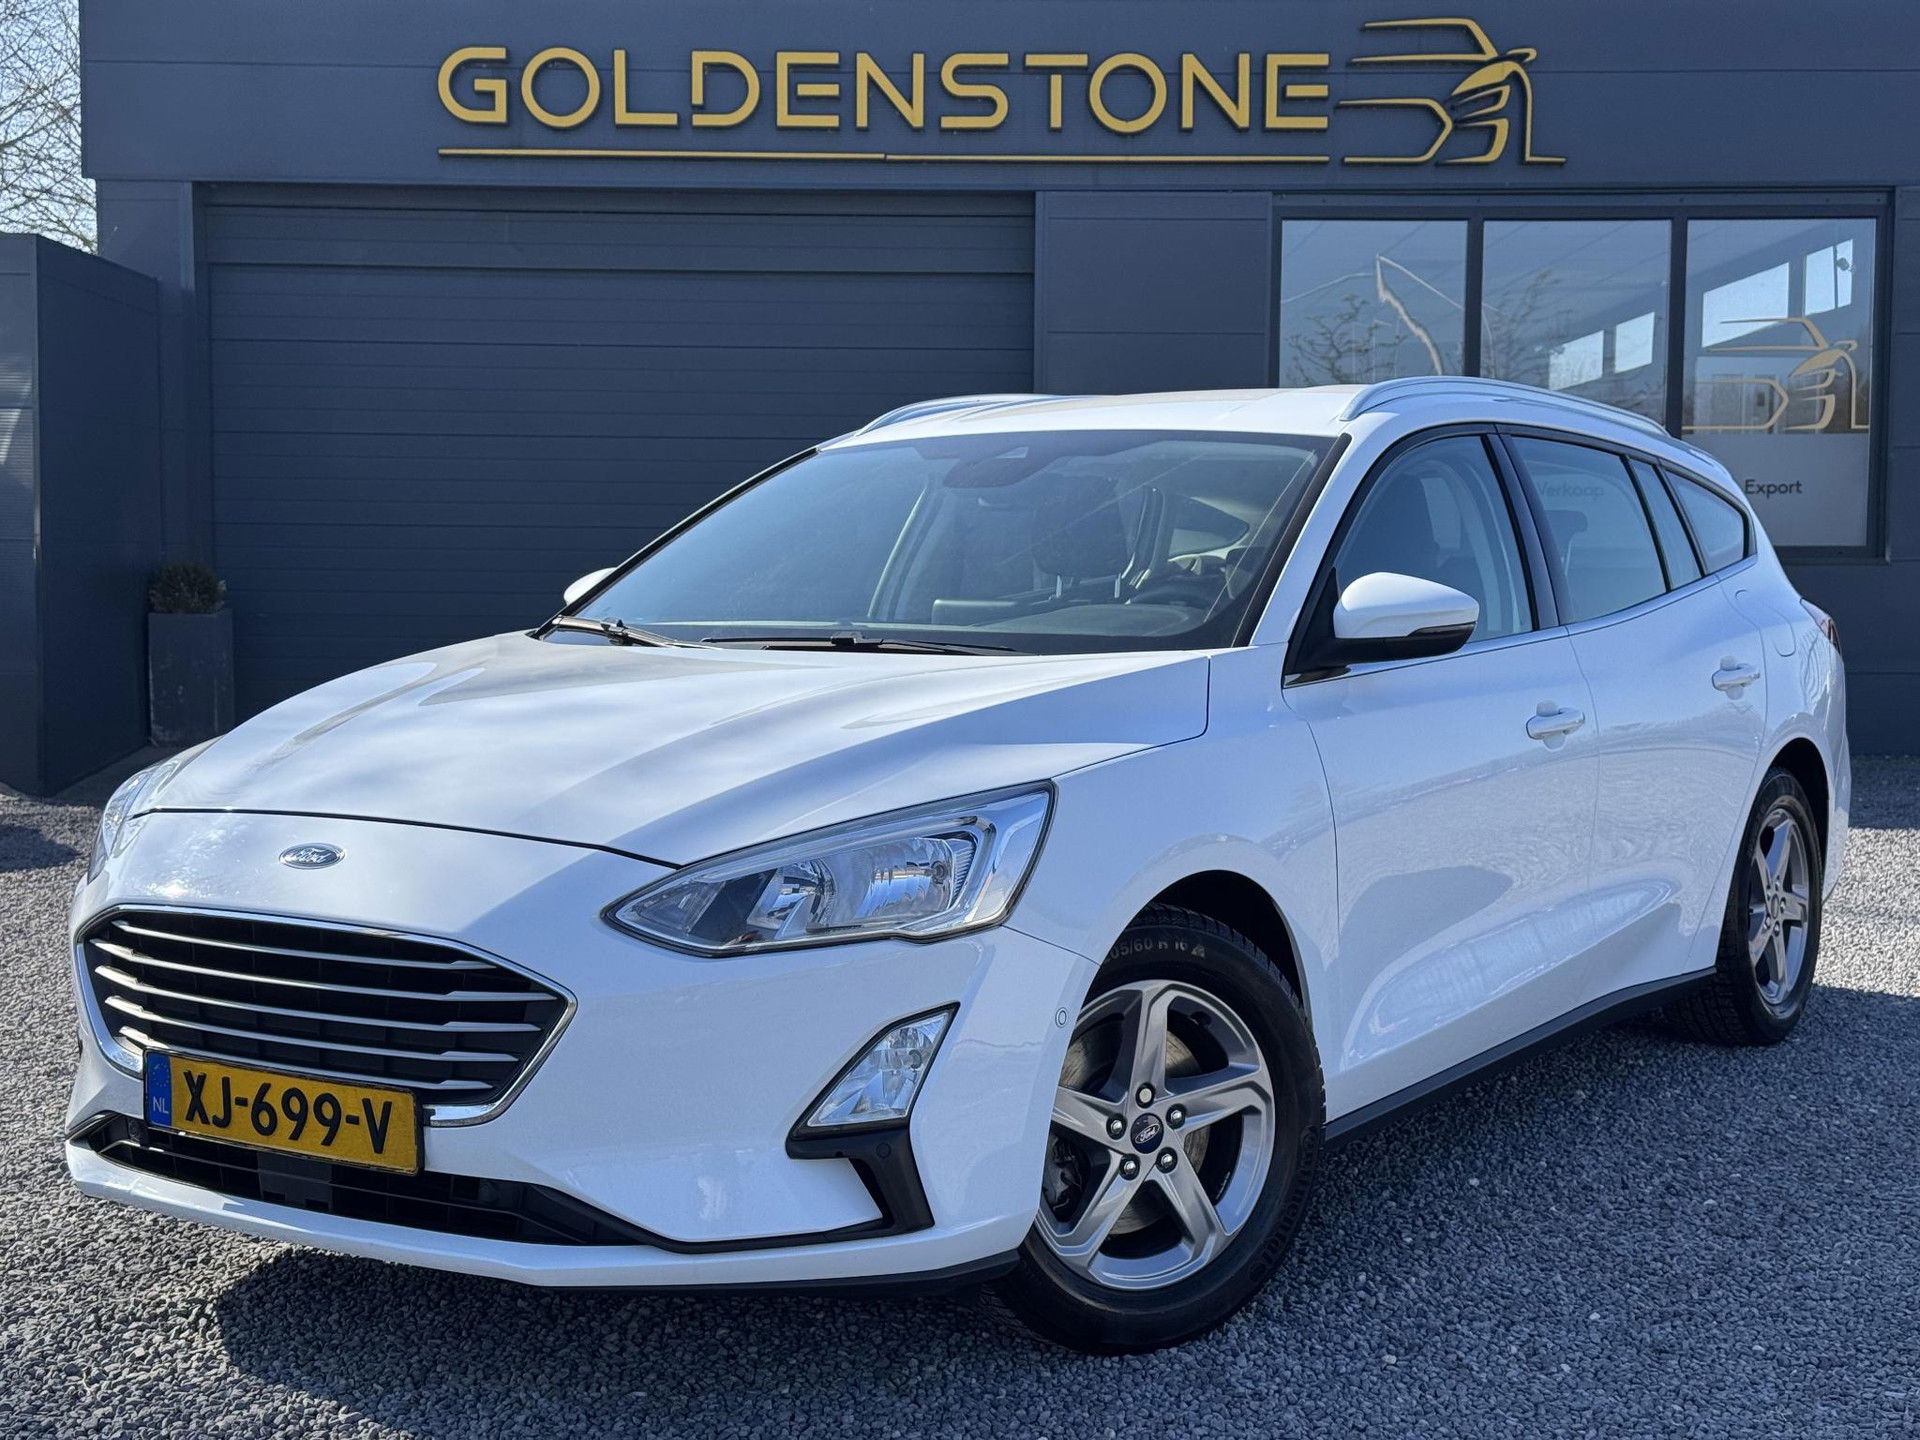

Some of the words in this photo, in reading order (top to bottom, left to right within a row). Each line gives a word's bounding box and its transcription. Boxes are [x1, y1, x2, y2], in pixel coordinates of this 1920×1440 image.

[437, 46, 1329, 133] GOLDENSTONE
[1745, 479, 1802, 499] Export
[153, 1096, 169, 1114] NL
[183, 1069, 392, 1155] XJ-699-V
